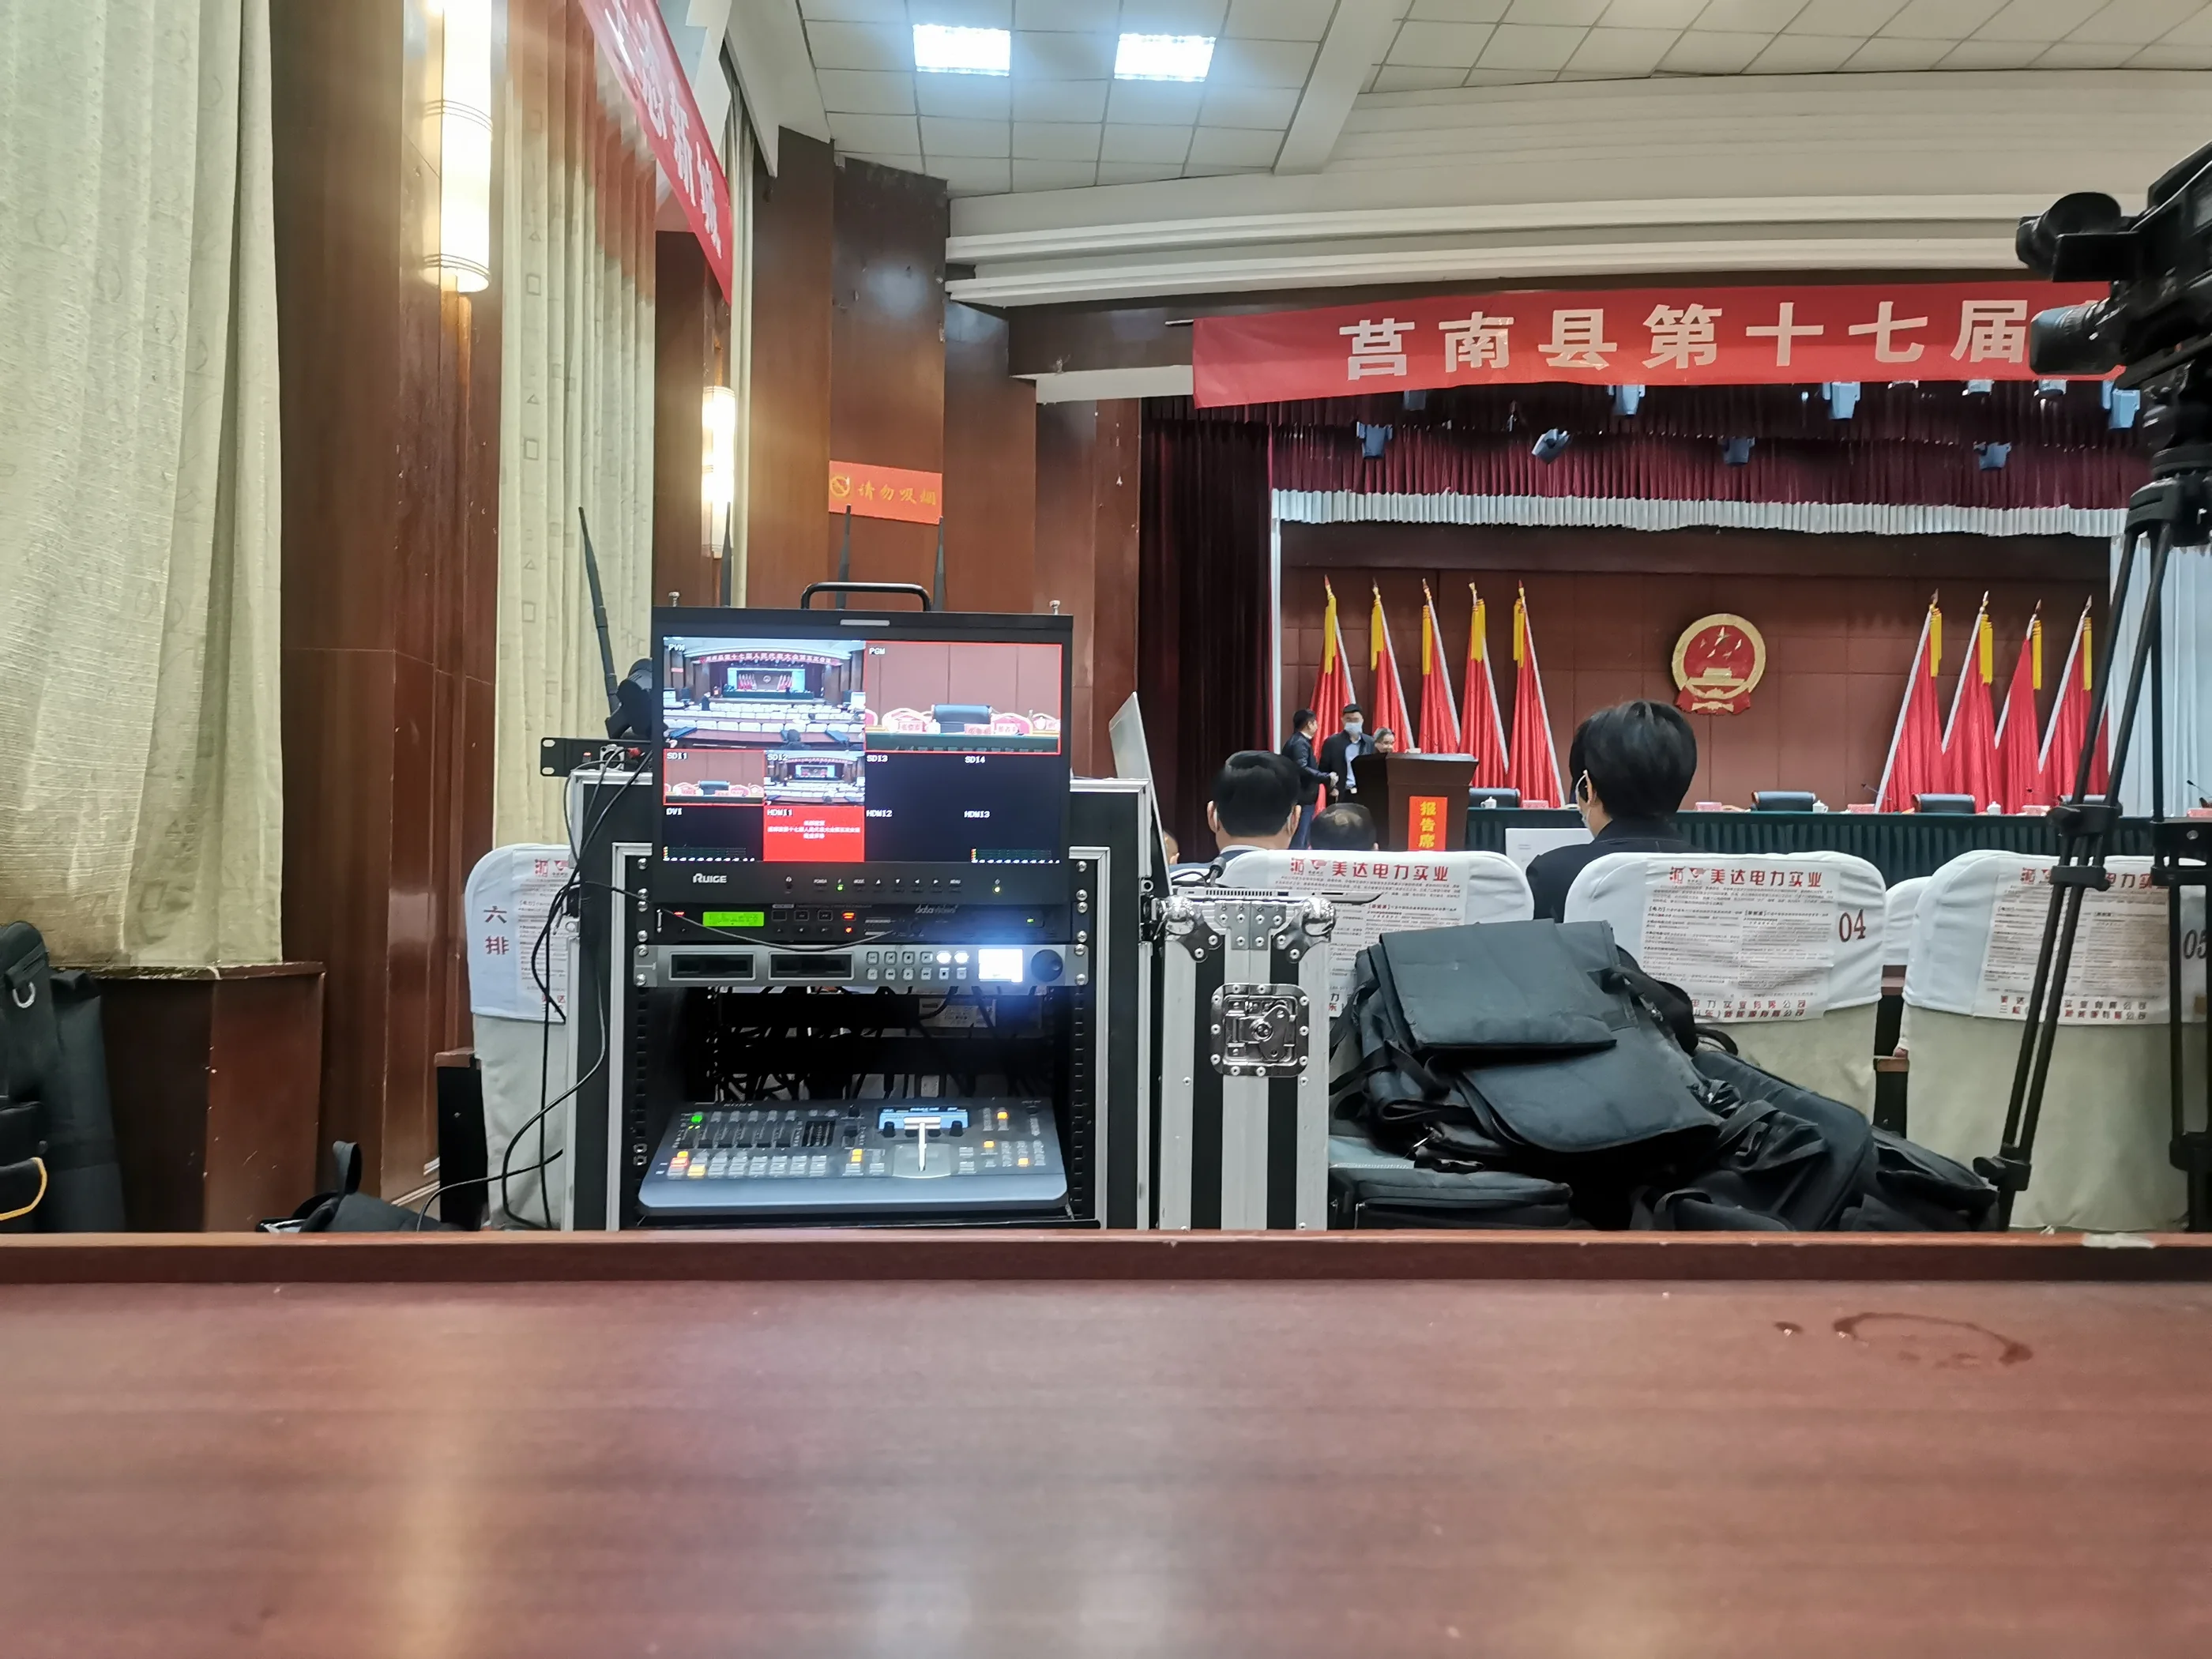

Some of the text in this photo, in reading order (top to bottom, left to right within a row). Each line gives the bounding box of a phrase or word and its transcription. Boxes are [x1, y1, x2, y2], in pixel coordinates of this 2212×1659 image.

[1338, 299, 2028, 382] 莒南县第十七届
[858, 480, 937, 506] 请勿吸烟
[767, 753, 788, 762] SDI2
[1418, 801, 1437, 849] 报告席
[1332, 861, 1449, 882] 美达电力实业
[1710, 868, 1823, 888] 美达电力实业
[483, 905, 510, 955] 六排
[1839, 908, 1866, 942] 04
